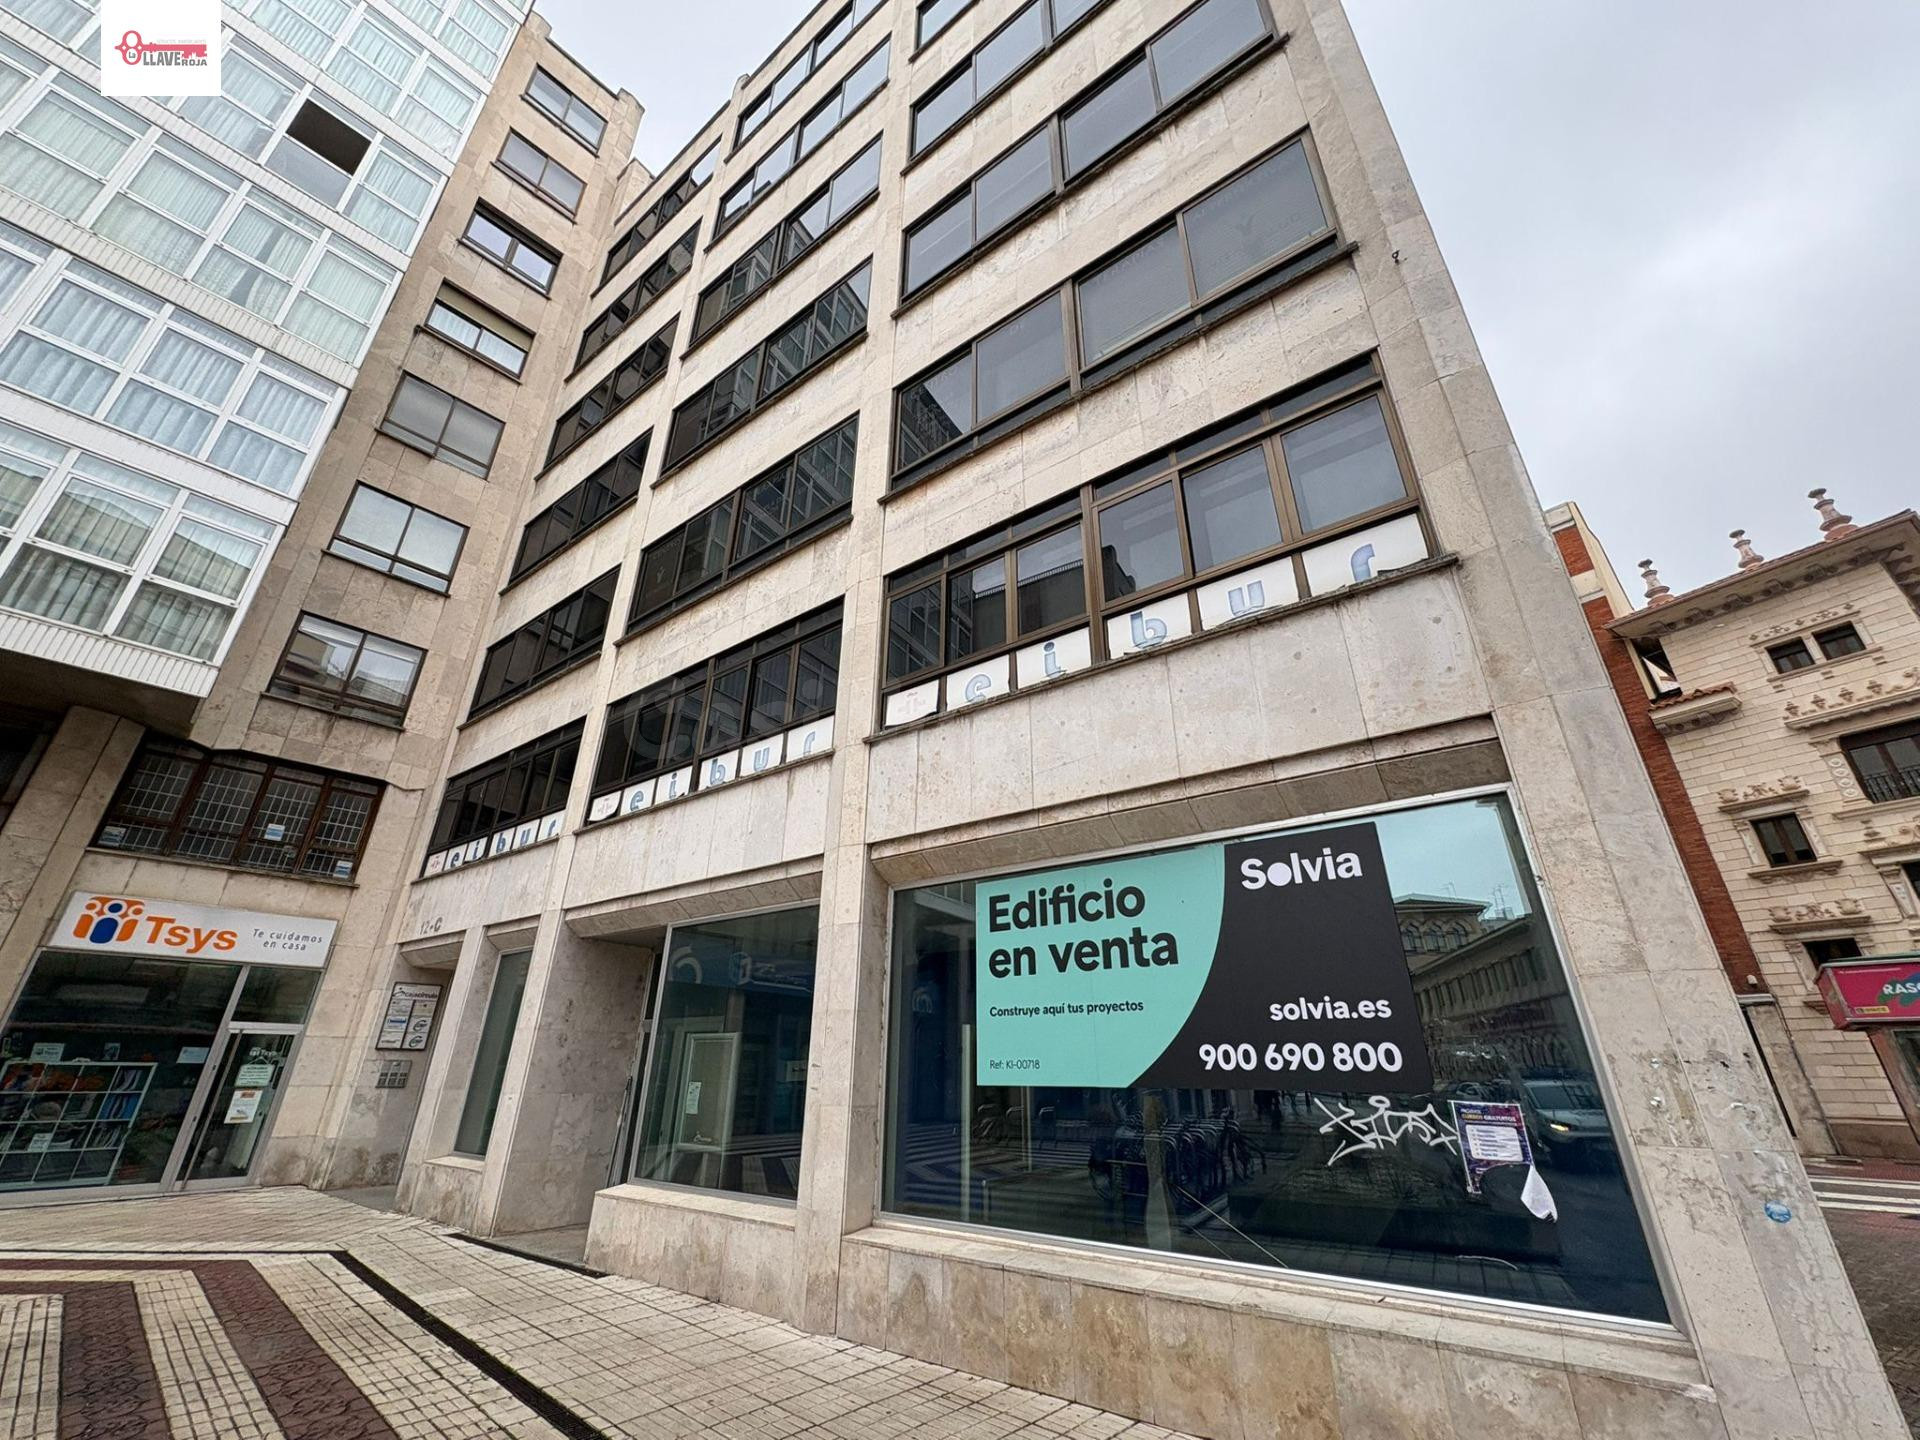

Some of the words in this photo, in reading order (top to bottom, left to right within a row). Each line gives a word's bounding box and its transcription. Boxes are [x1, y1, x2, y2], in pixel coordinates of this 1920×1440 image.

[1240, 847, 1363, 890] Solvia
[989, 878, 1146, 933] Edificio
[146, 915, 239, 954] Tsys
[253, 928, 265, 938] Te
[269, 931, 323, 943] cuidamos
[263, 940, 277, 948] en
[282, 942, 307, 951] casa
[988, 948, 1037, 979] en
[1048, 926, 1179, 973] venta
[989, 1006, 1041, 1018] Construye
[1042, 1002, 1066, 1017] aquí
[1067, 1003, 1085, 1014] tus
[1086, 1000, 1145, 1015] proyectos
[1269, 995, 1393, 1021] solvia.es
[989, 1060, 1004, 1070] Ref:
[1199, 1043, 1258, 1071] 900
[1264, 1042, 1326, 1072] 690
[1331, 1041, 1403, 1073] 800
